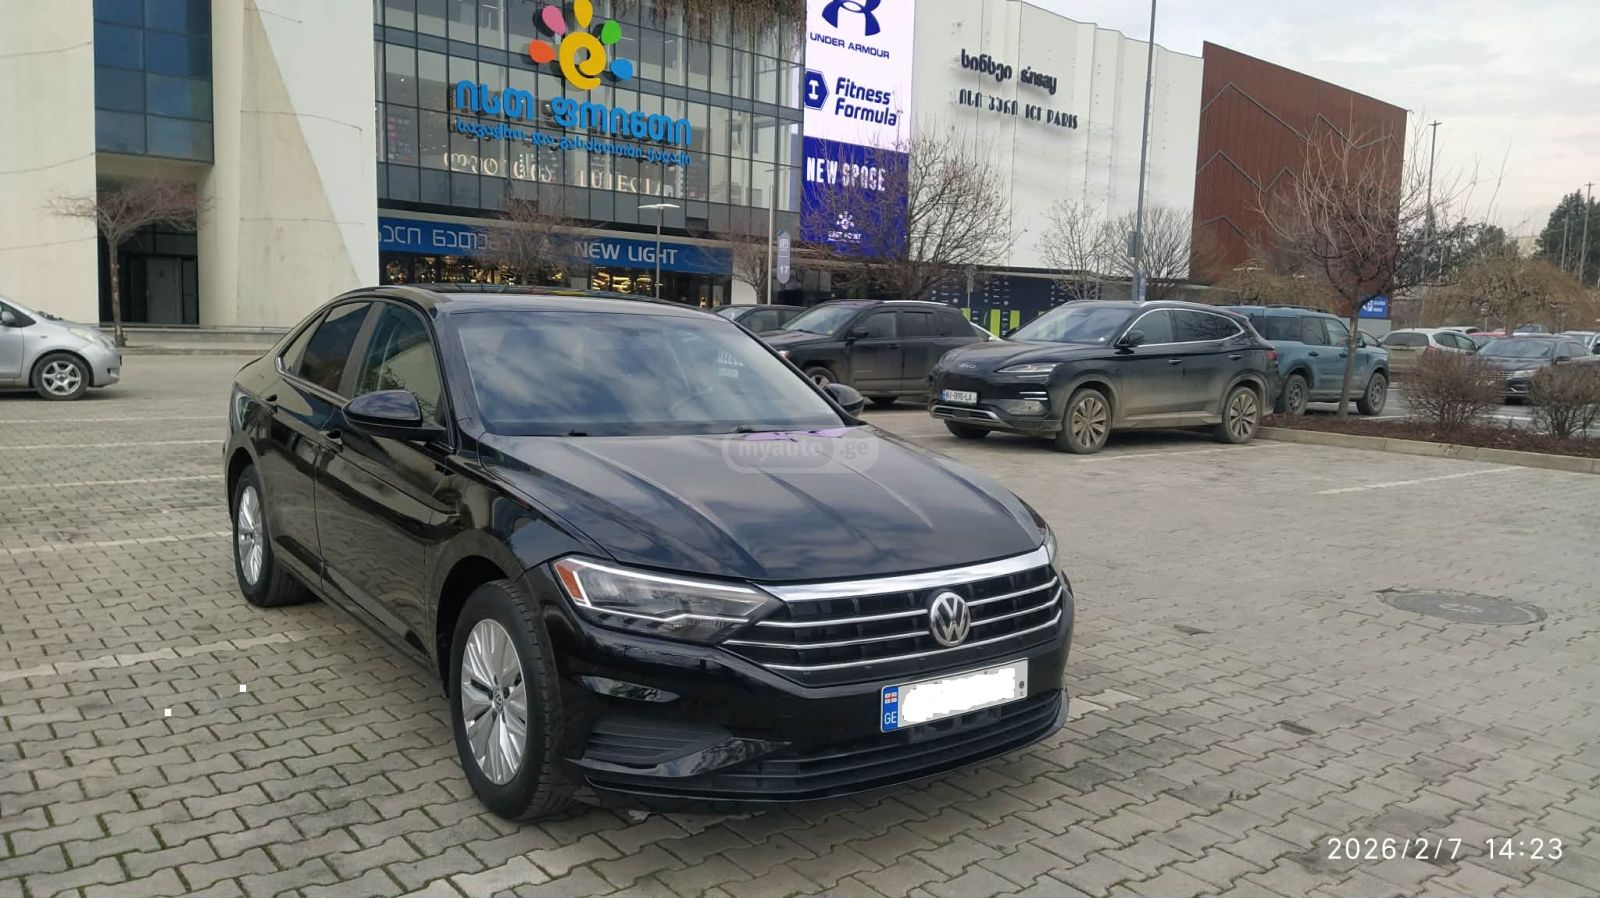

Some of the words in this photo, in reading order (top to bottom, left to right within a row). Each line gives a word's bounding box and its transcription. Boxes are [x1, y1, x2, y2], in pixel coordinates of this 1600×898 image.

[809, 31, 846, 49] UNDER
[847, 41, 890, 60] ARMOUR
[835, 76, 891, 105] Fitness
[1020, 66, 1058, 95] sinsay
[455, 80, 534, 121] ისთ
[551, 96, 692, 145] ფოინთი
[834, 97, 898, 126] Formula
[1024, 103, 1042, 122] ICI
[1046, 108, 1079, 130] PARIS
[806, 156, 838, 185] NEW
[575, 241, 621, 260] NEW
[627, 246, 678, 265] LIGHT
[884, 712, 897, 725] GE
